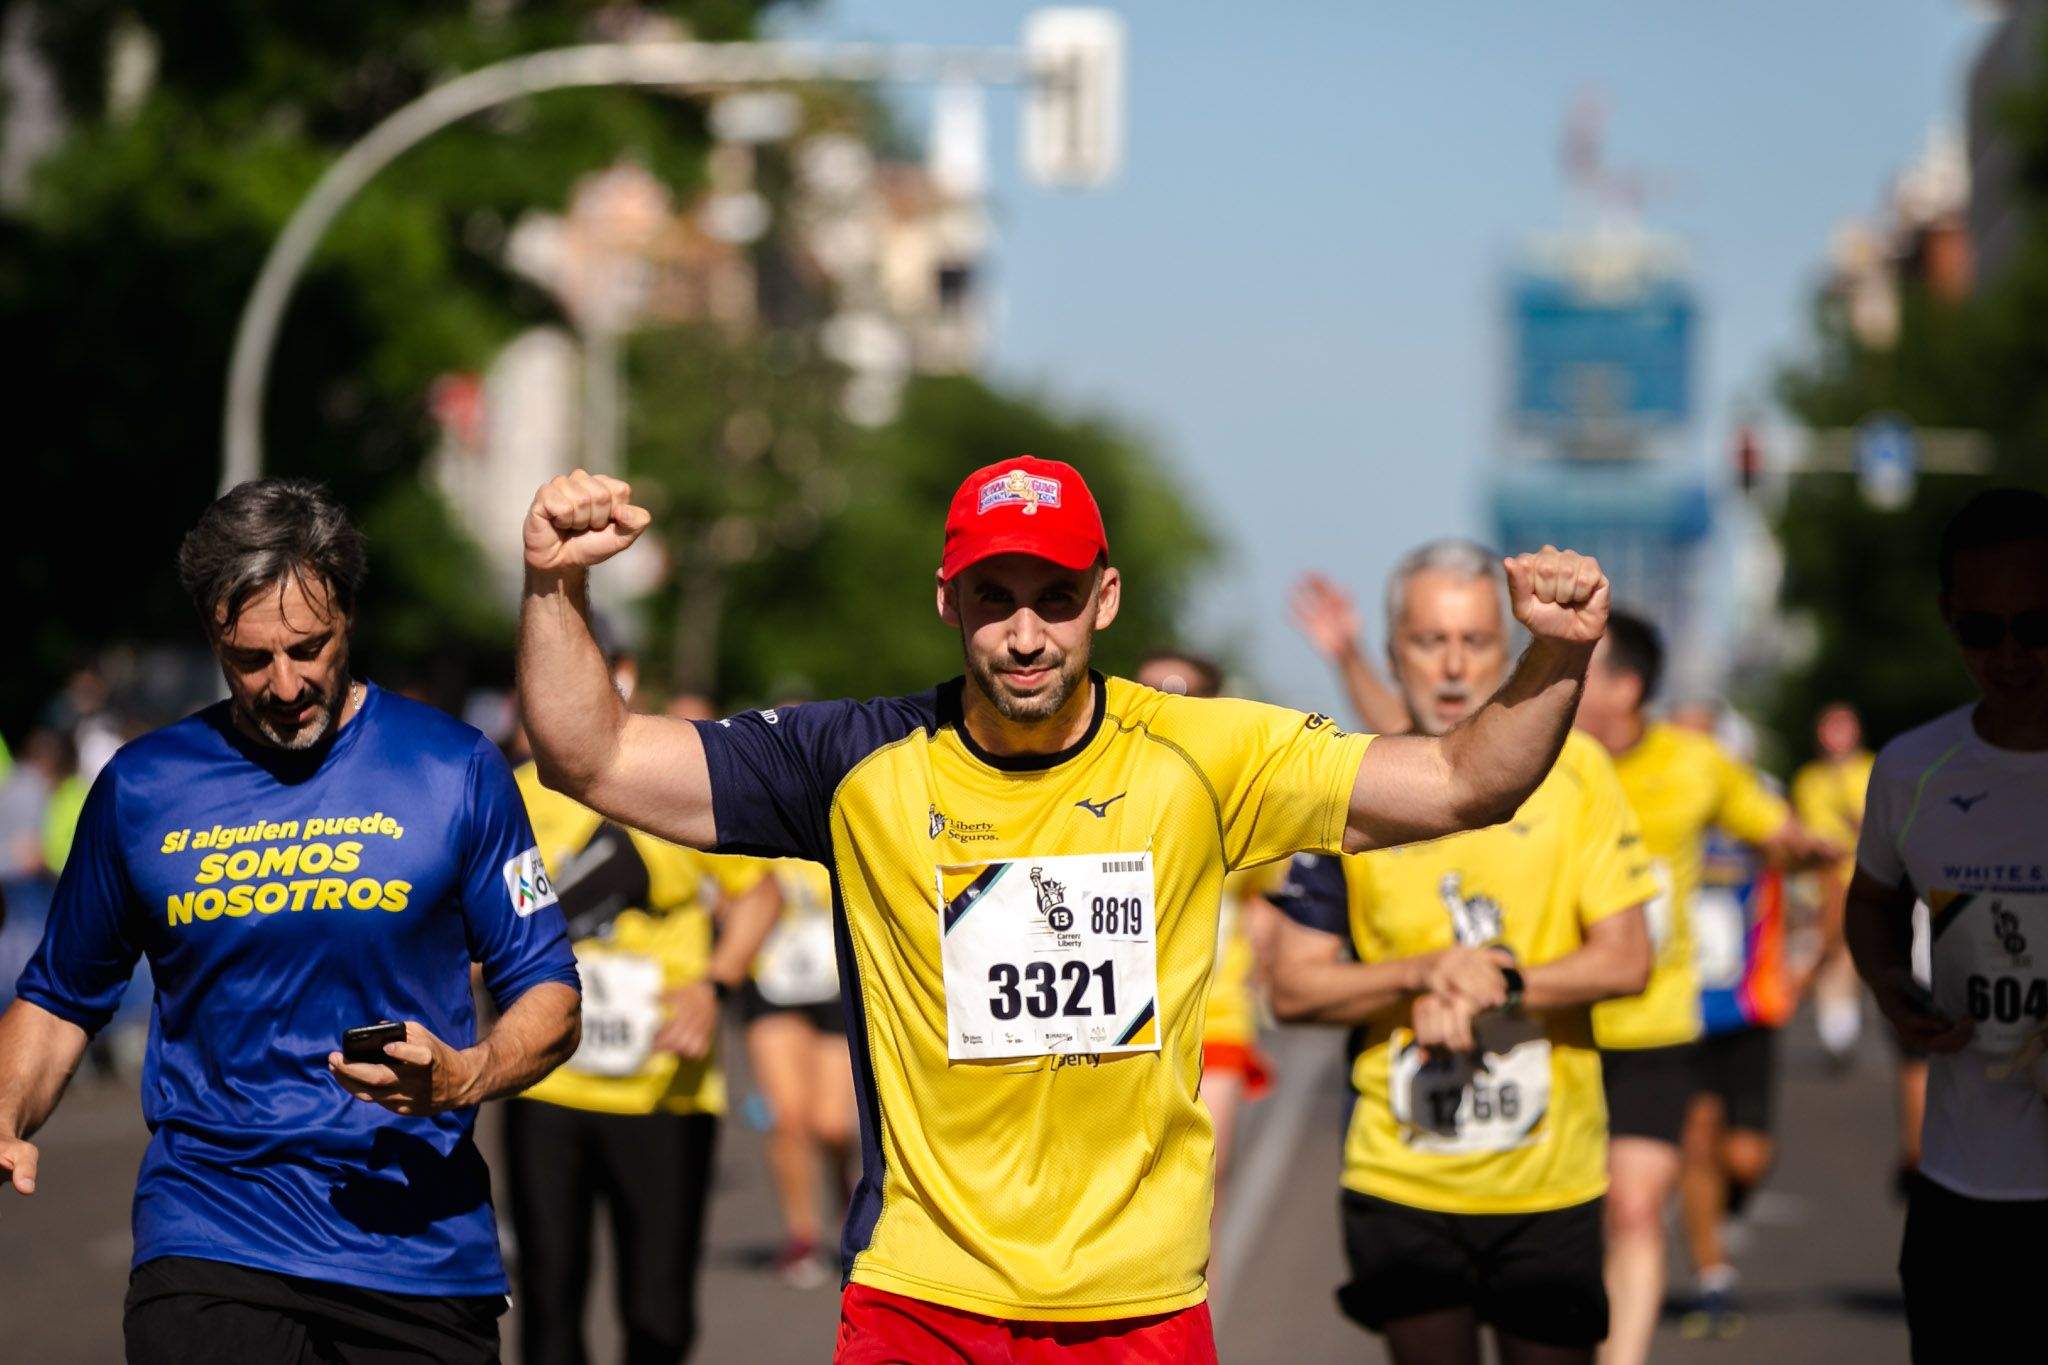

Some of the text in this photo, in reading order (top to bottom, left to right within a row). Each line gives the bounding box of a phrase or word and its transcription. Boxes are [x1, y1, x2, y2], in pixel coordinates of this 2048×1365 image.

[160, 812, 404, 854] Si alguien puede,
[948, 829, 999, 843] Seguros.
[950, 818, 993, 833] Liberty
[194, 840, 364, 885] SOMOS
[1943, 864, 2021, 880] WHITE
[167, 877, 413, 927] NOSOTROS
[1090, 896, 1142, 935] 8819
[1052, 911, 1070, 927] 13
[1057, 940, 1082, 948] Liberty
[987, 959, 1117, 1020] 3321
